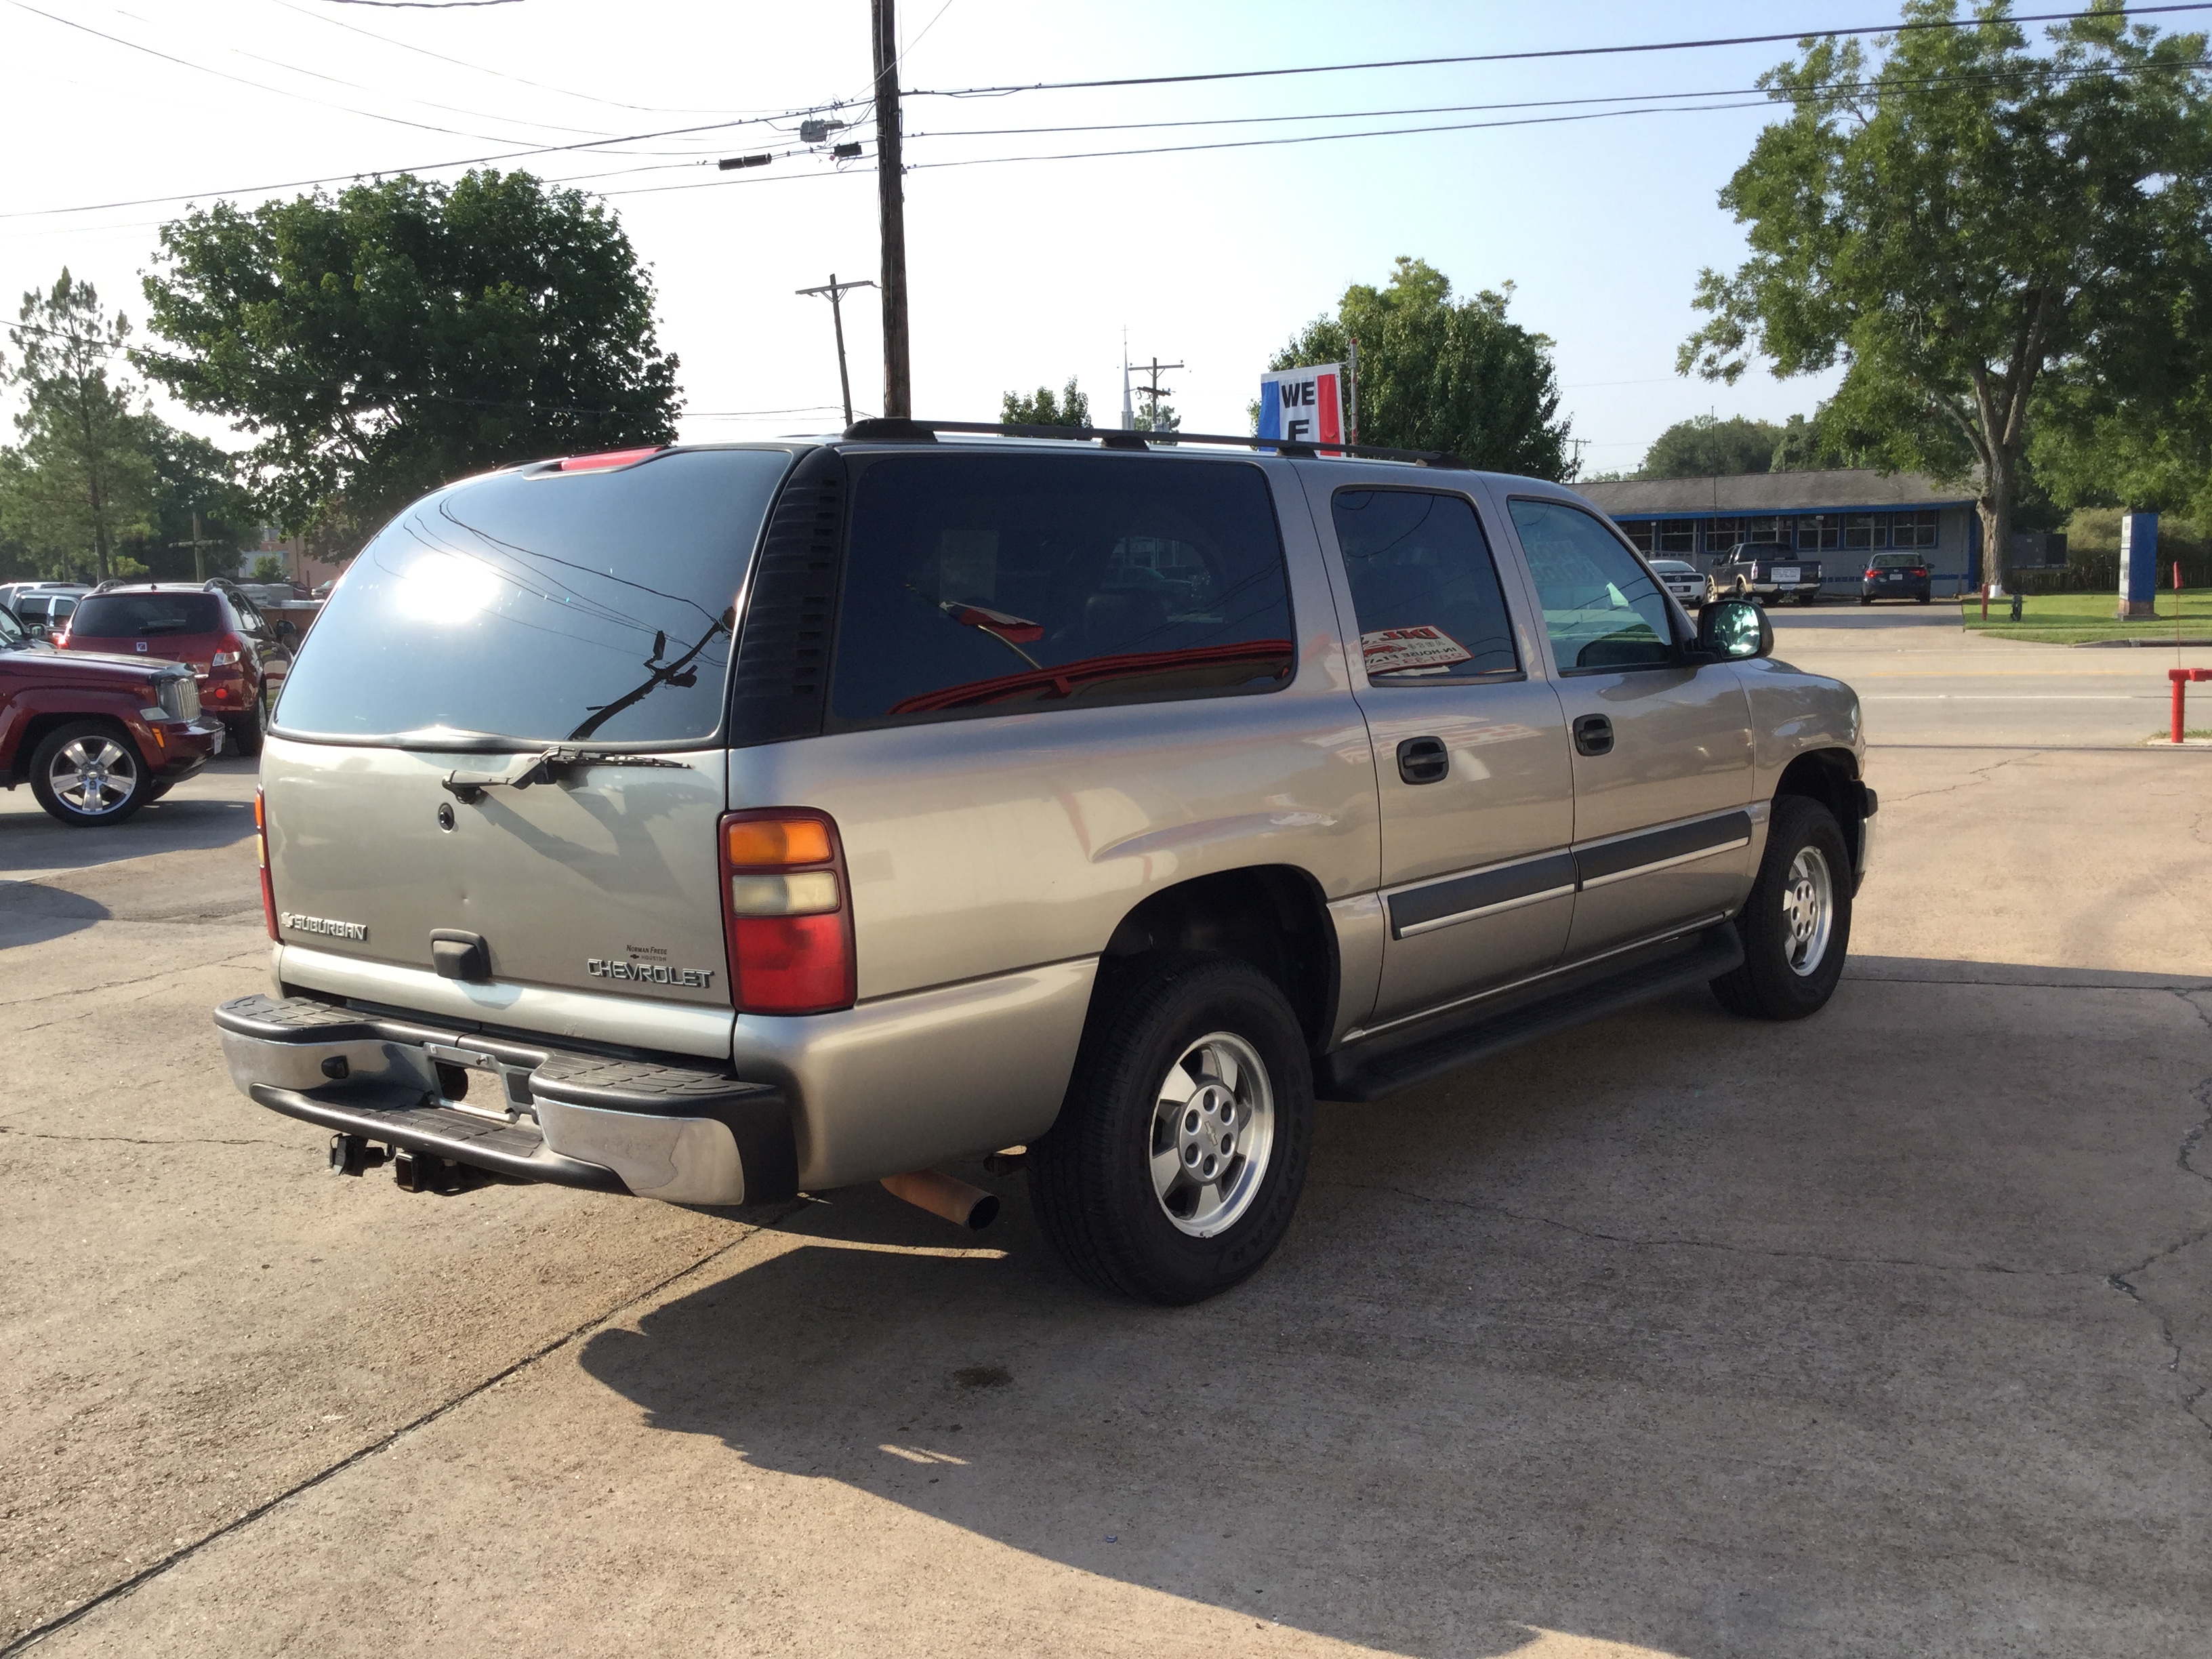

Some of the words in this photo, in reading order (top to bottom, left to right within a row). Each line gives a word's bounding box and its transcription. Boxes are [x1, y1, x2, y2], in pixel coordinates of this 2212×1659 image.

[1281, 381, 1315, 409] WE
[294, 914, 367, 941] SUBURBAN
[588, 958, 714, 988] CHEVROLET
